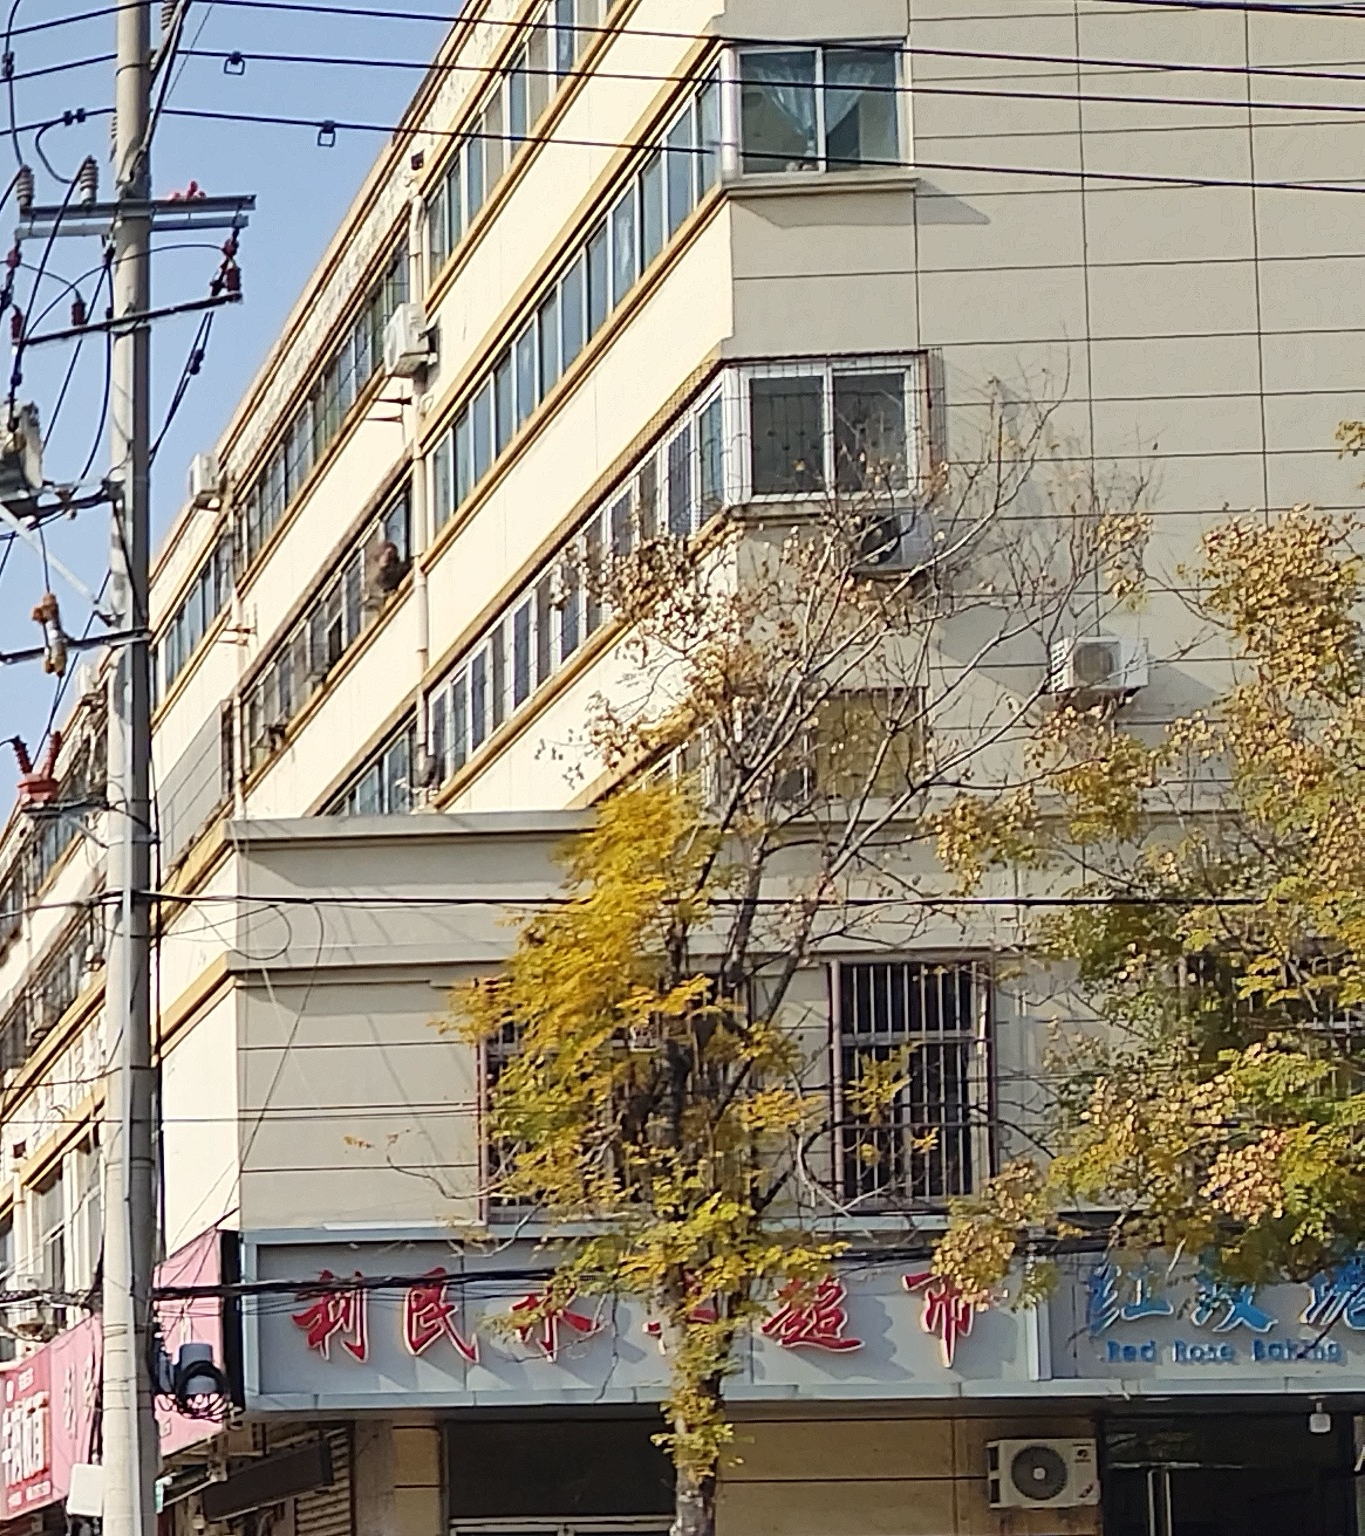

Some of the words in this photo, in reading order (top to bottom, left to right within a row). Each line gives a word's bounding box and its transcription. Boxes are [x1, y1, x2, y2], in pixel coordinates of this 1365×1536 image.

[292, 1266, 976, 1368] 利民水超市
[1106, 1340, 1157, 1362] Red
[1173, 1340, 1236, 1362] Rose
